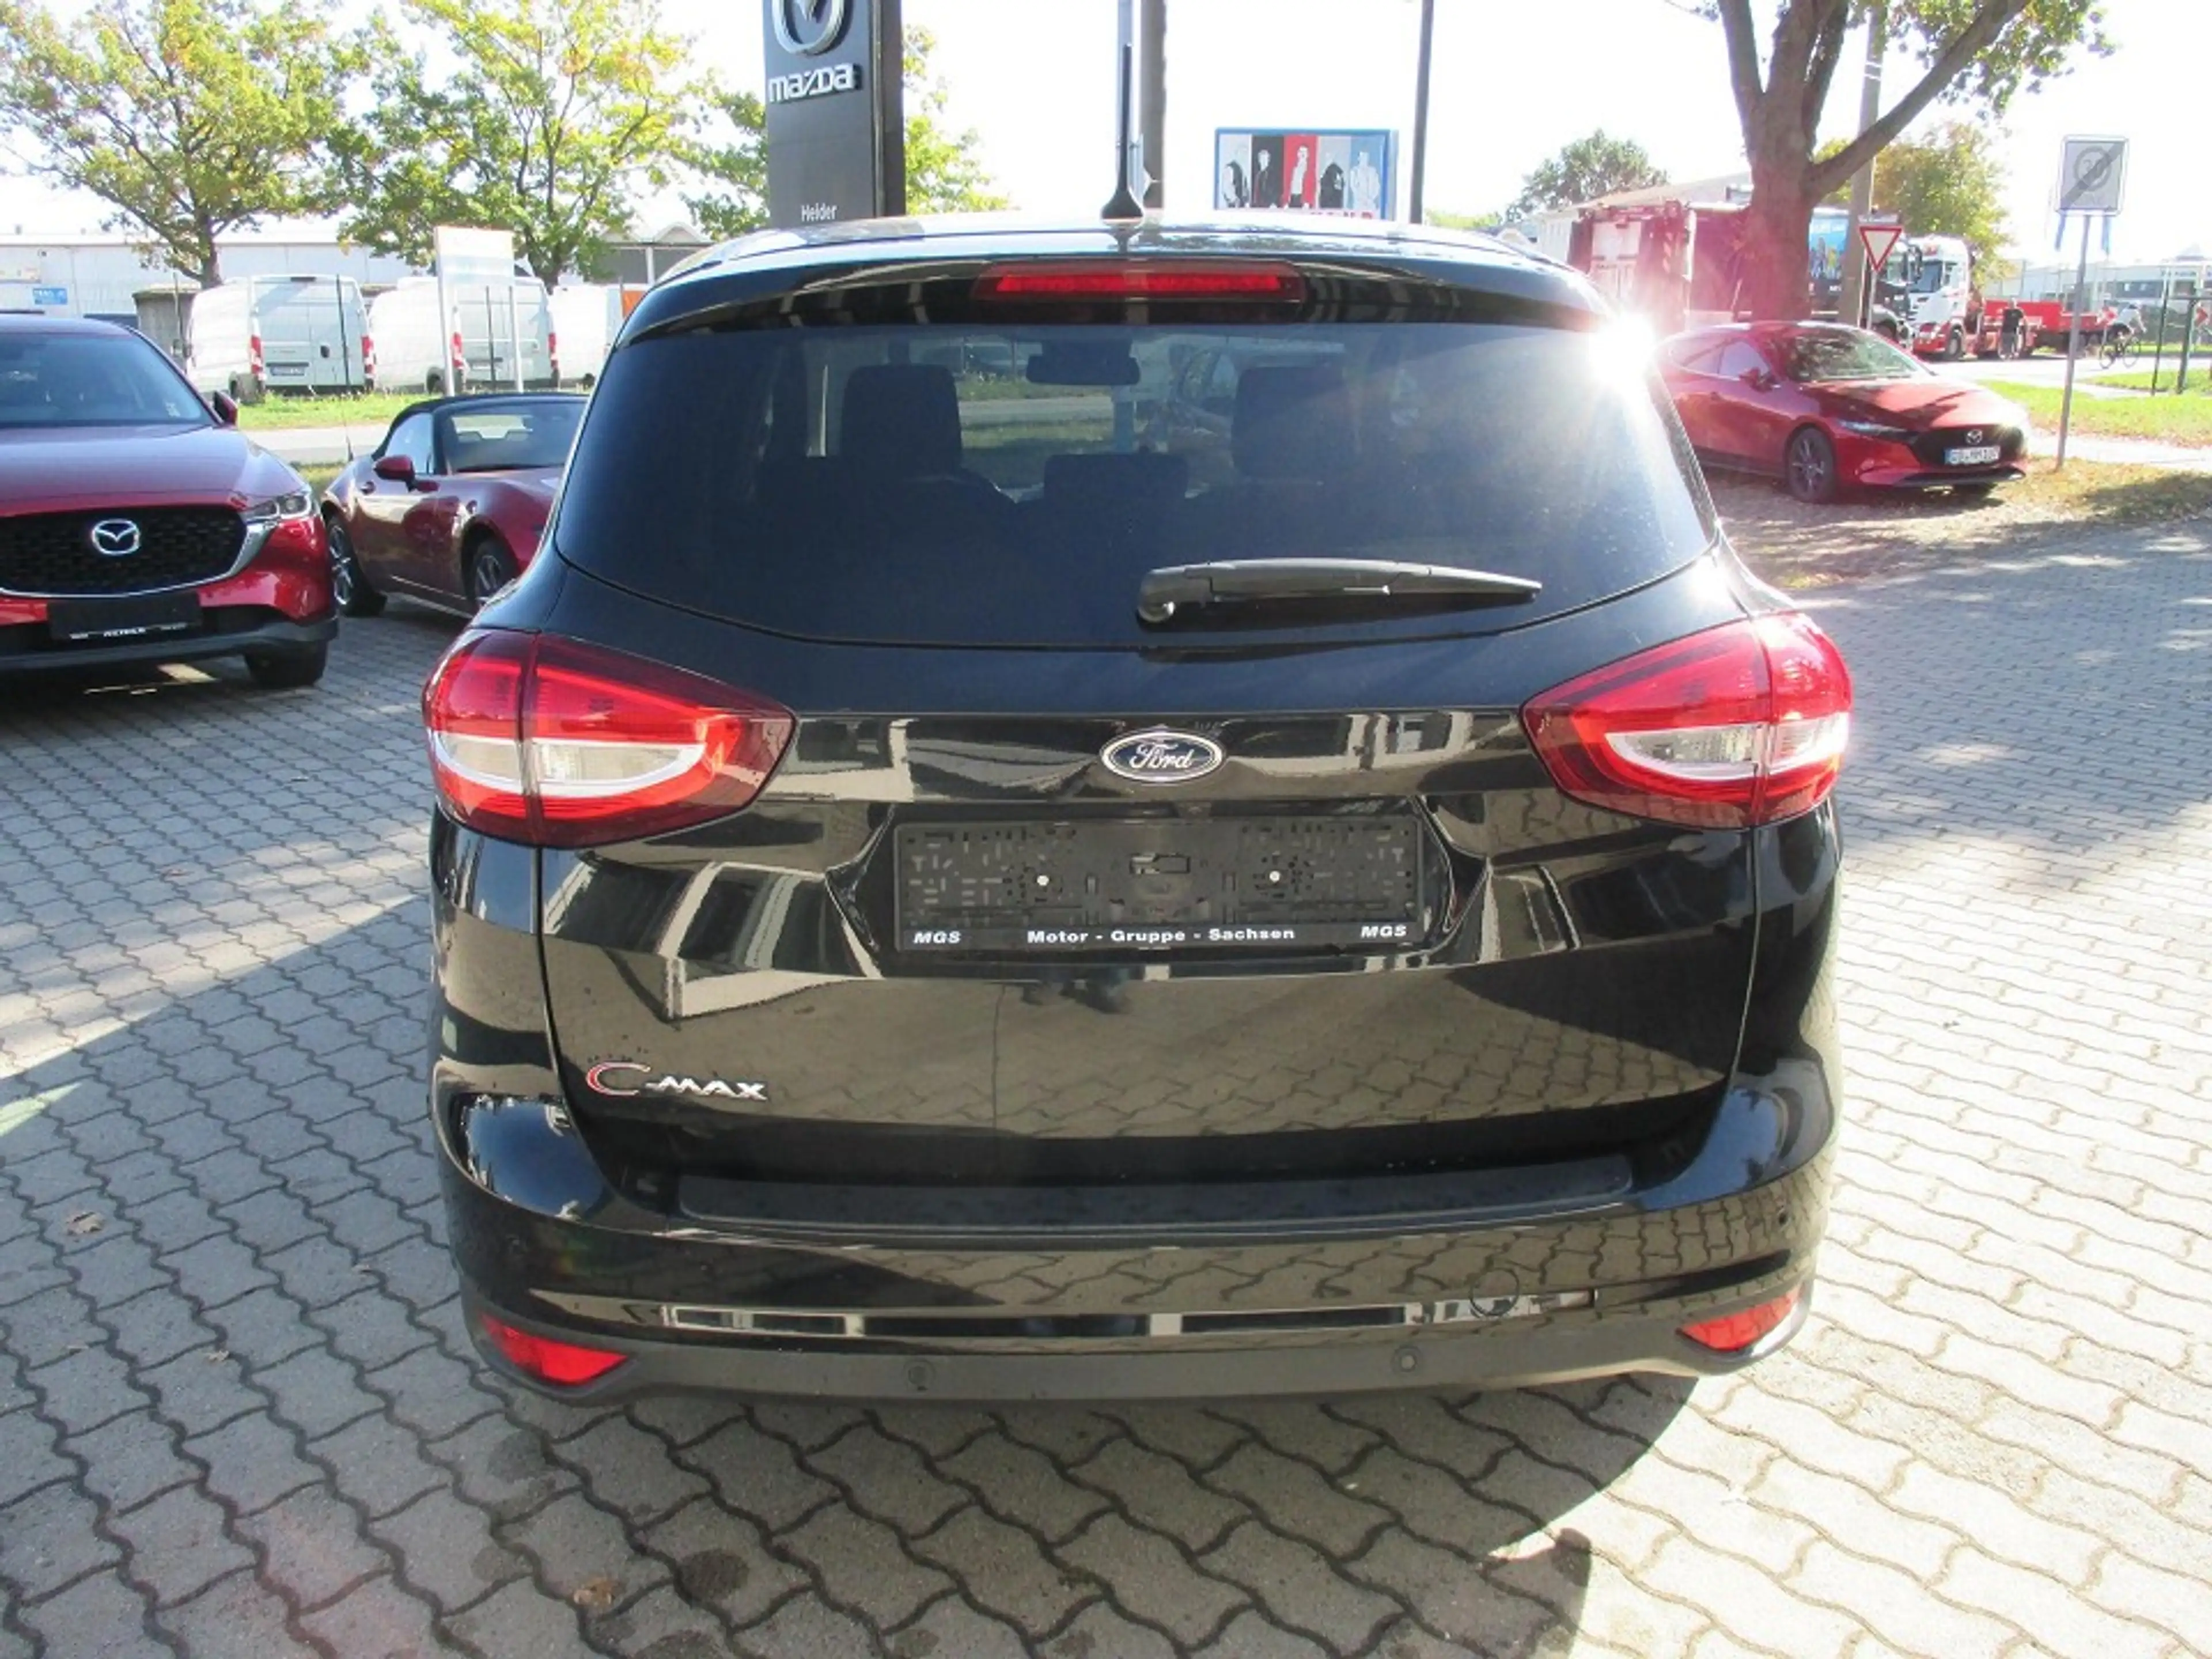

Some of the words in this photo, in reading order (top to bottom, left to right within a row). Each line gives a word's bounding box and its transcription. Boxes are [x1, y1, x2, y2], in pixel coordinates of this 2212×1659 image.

[1129, 743, 1195, 768] Ford
[912, 930, 961, 944] MGS
[1027, 930, 1089, 944] Motor
[1111, 929, 1185, 945] Gruppe
[1208, 927, 1296, 941] Sachsen
[1360, 925, 1407, 938] MGS
[585, 1062, 768, 1101] C-MAX
